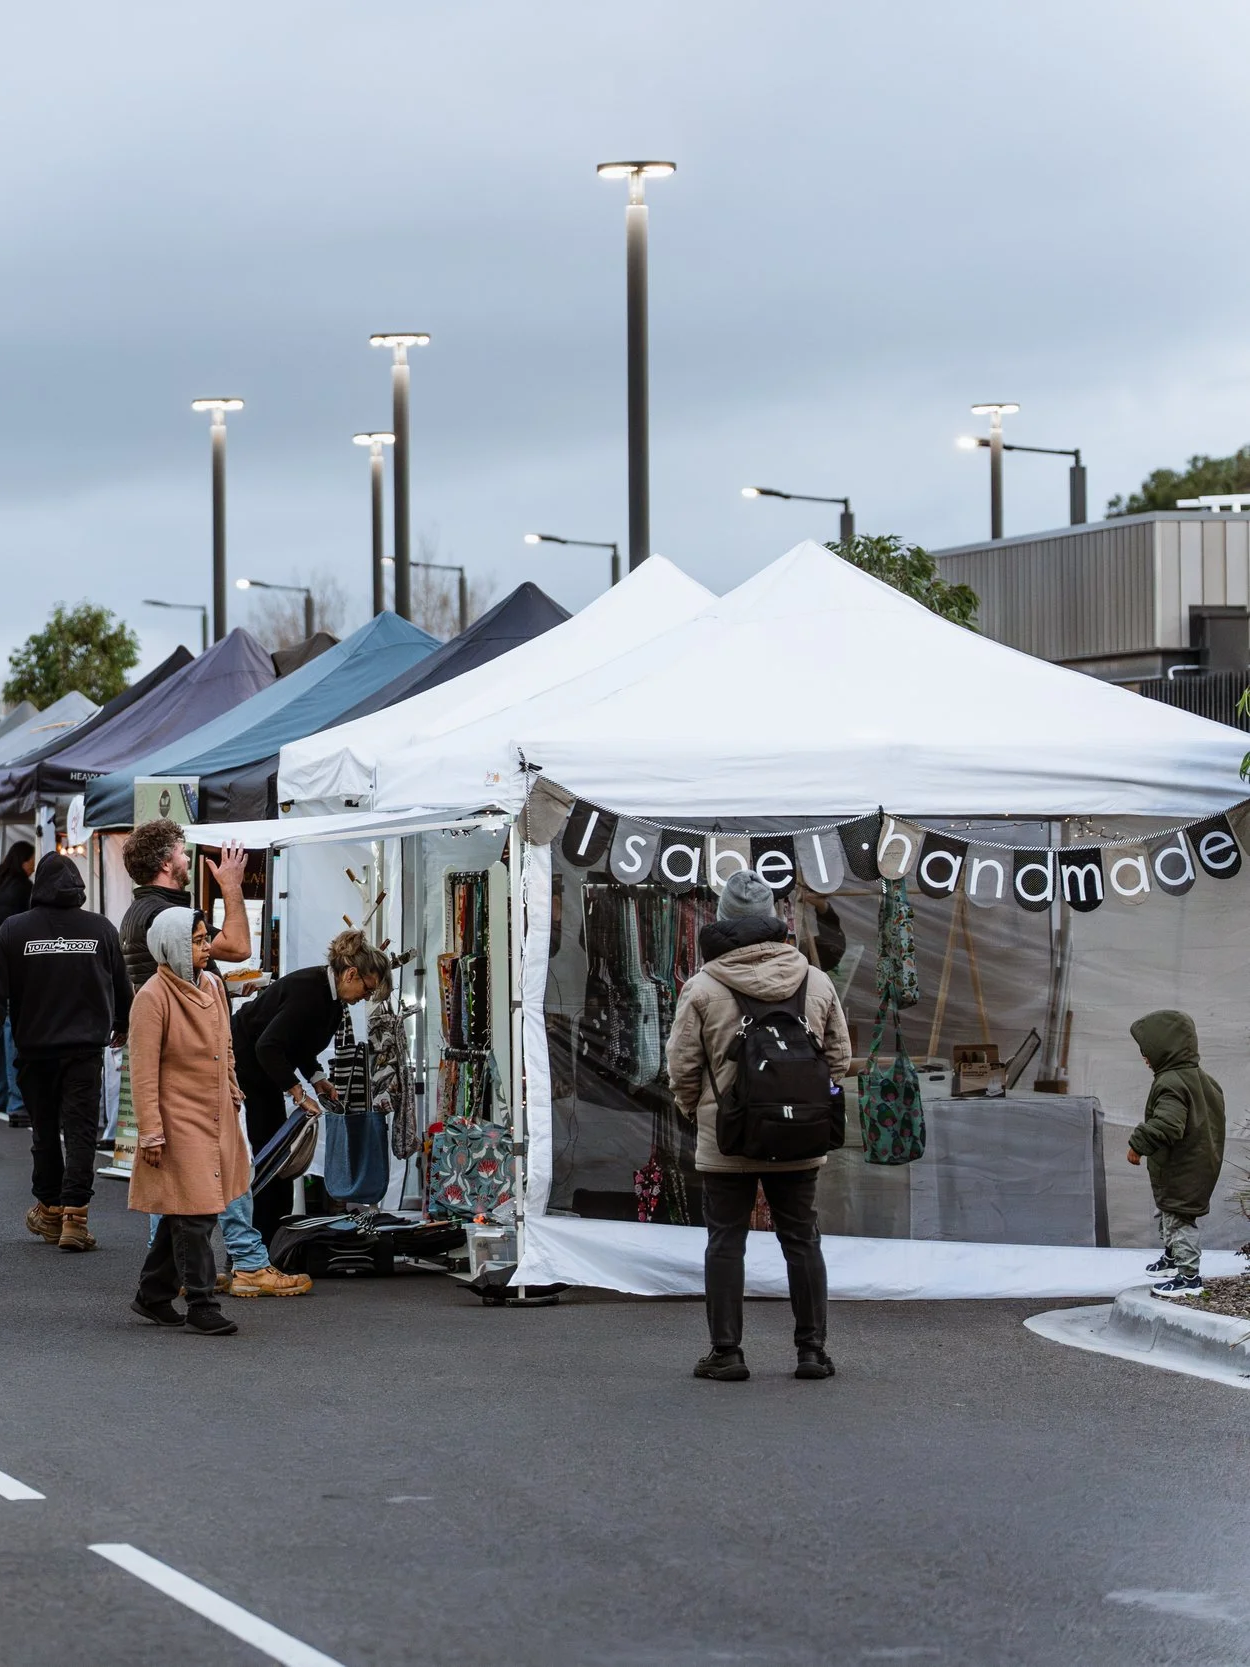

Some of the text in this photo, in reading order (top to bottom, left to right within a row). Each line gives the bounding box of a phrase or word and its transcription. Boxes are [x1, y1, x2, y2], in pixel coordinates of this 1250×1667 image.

[577, 810, 1238, 903] Isabel handmade
[28, 941, 94, 953] TOTAL TOOLS
